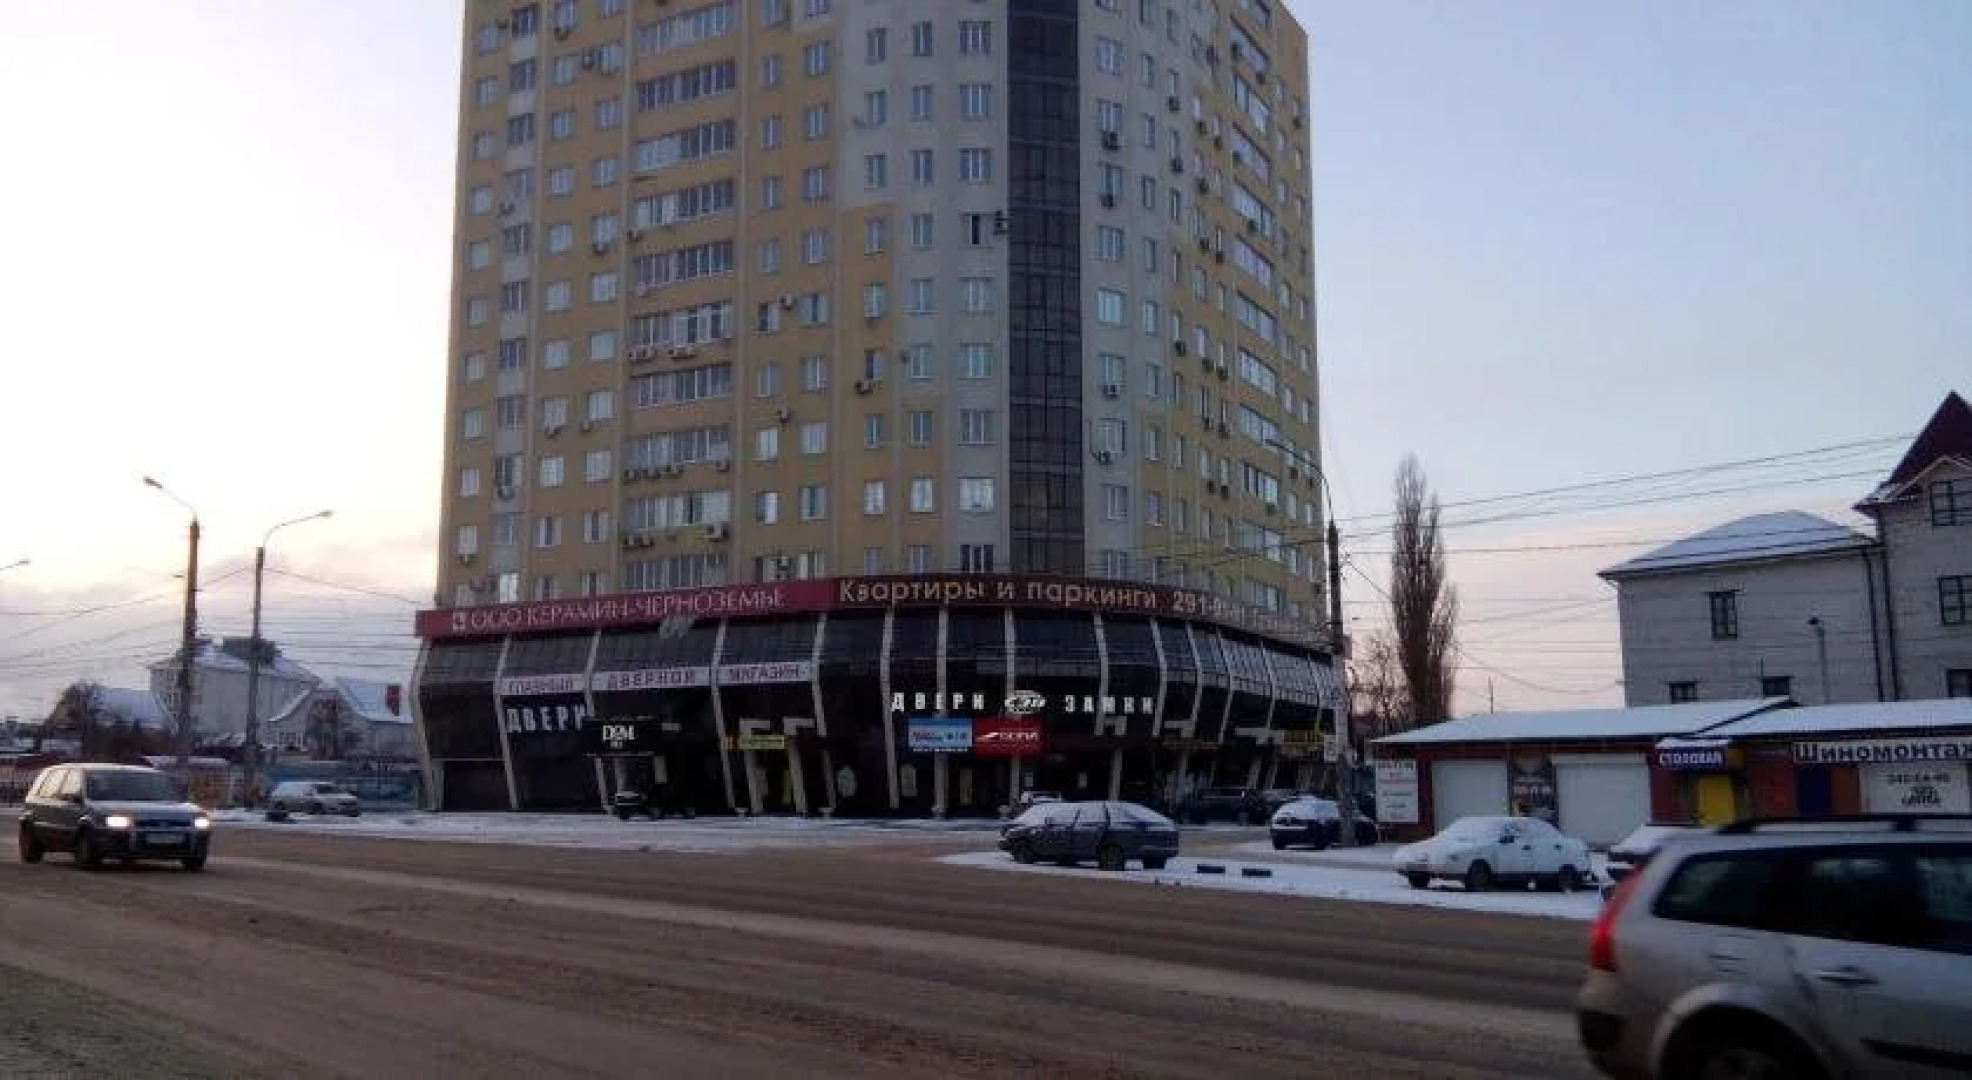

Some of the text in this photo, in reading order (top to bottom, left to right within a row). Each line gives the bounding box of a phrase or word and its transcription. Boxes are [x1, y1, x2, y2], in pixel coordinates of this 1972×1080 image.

[839, 580, 985, 605] Квартиры
[998, 581, 1015, 600] и
[1028, 581, 1156, 608] паркинги
[892, 692, 984, 712] ДВЕРИ
[1065, 695, 1153, 714] ЗАМКИ
[506, 704, 586, 733] ДВЕРИ
